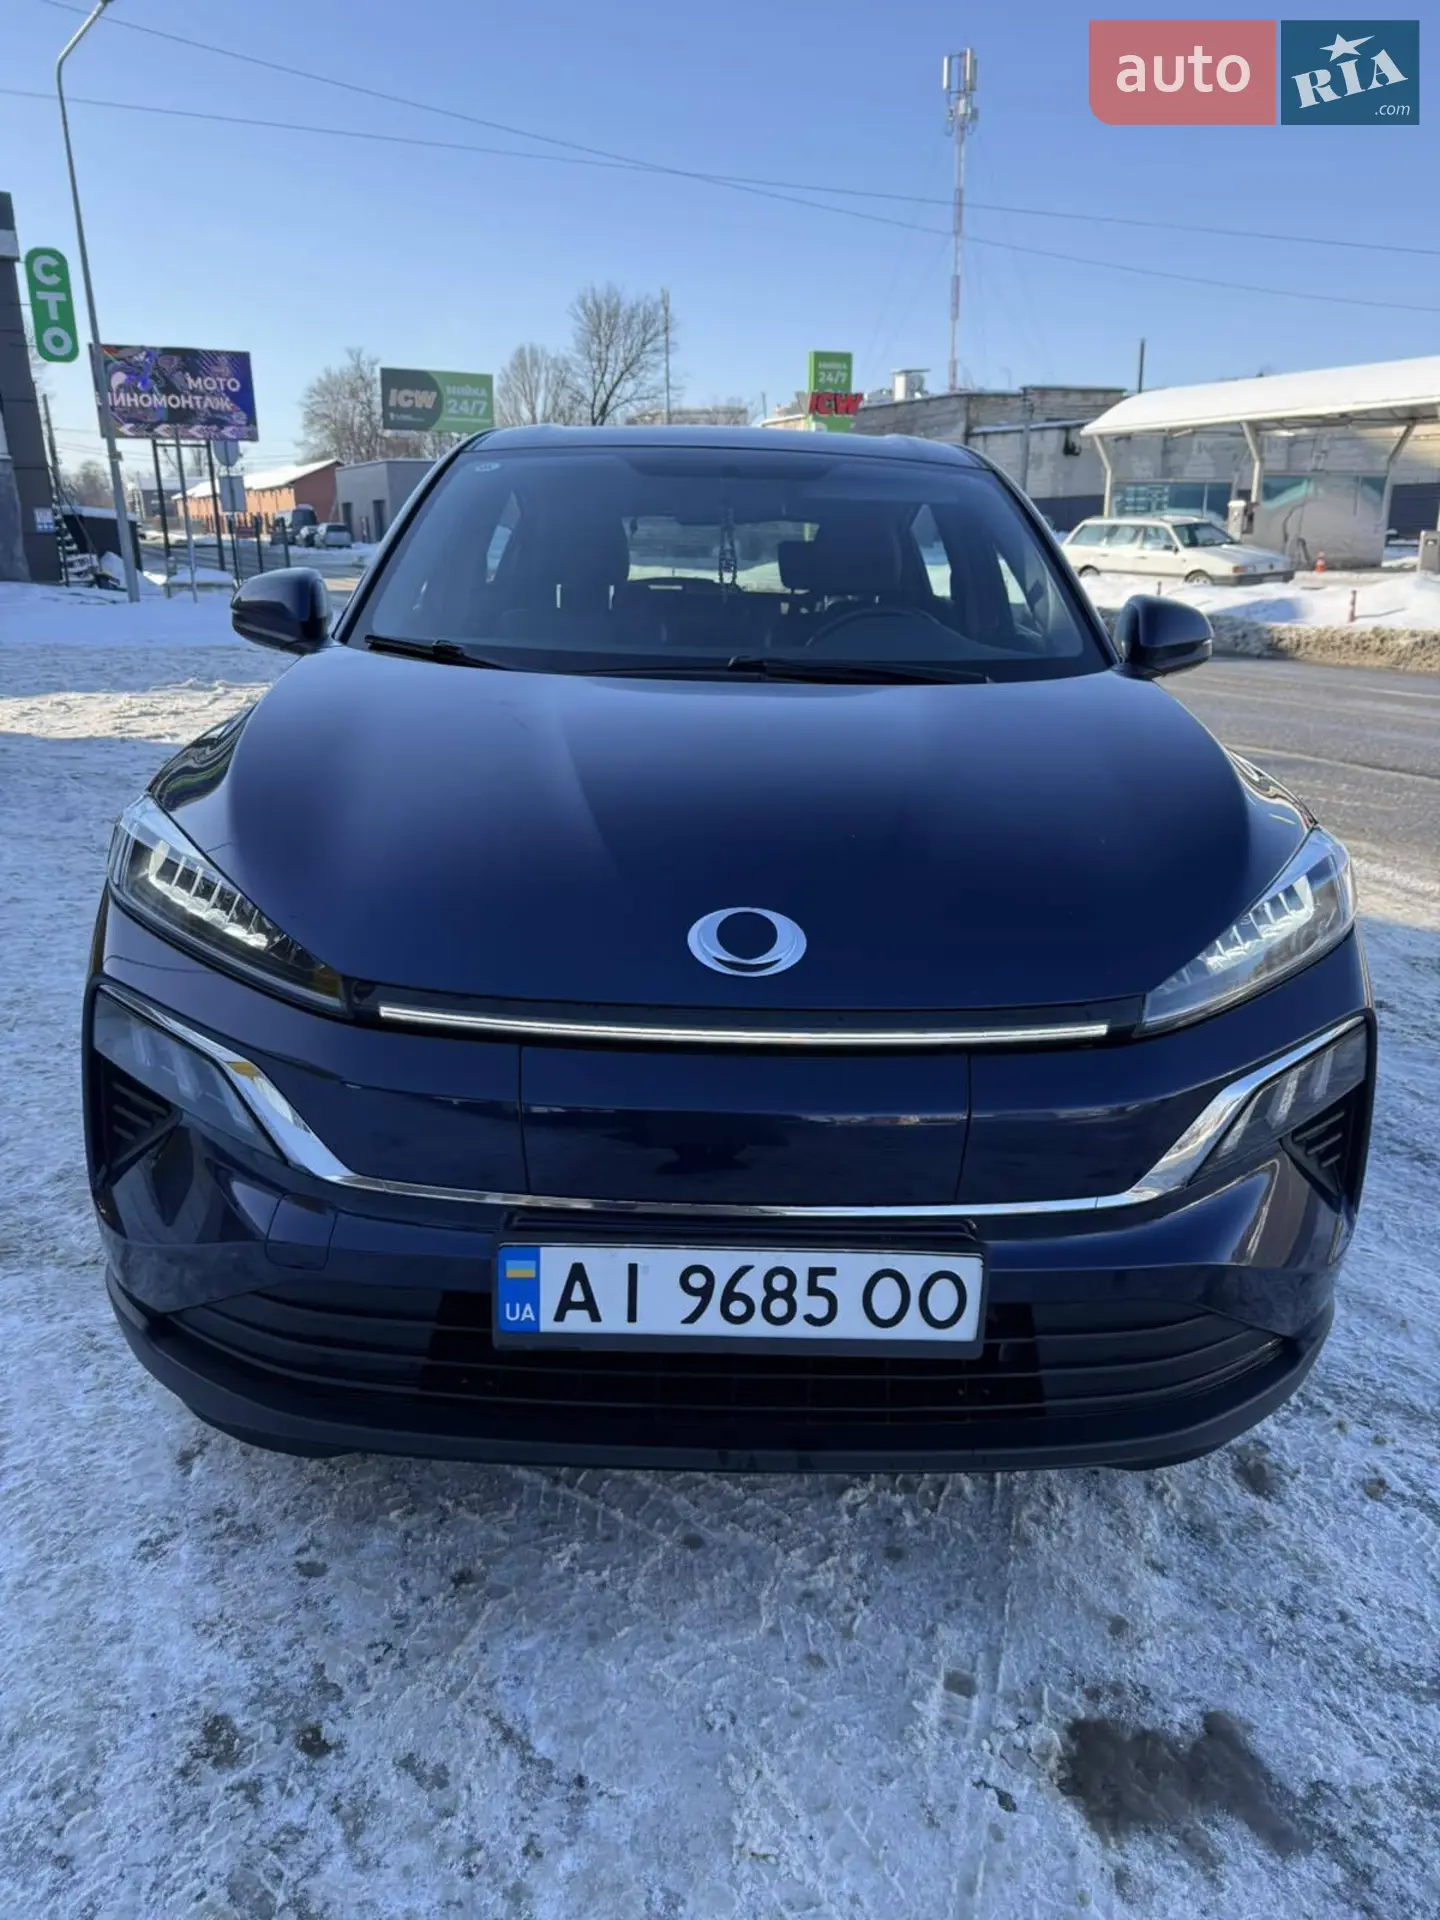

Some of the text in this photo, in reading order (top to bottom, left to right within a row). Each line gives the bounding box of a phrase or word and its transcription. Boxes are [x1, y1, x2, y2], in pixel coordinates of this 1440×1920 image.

[33, 255, 73, 356] СТО
[187, 376, 241, 392] МОТО
[818, 370, 848, 384] 24/7
[388, 388, 437, 409] ICW
[446, 398, 488, 416] 24/7
[808, 391, 864, 416] ICW
[553, 1262, 638, 1323] AI
[679, 1265, 838, 1327] 9685
[505, 1303, 536, 1322] UA
